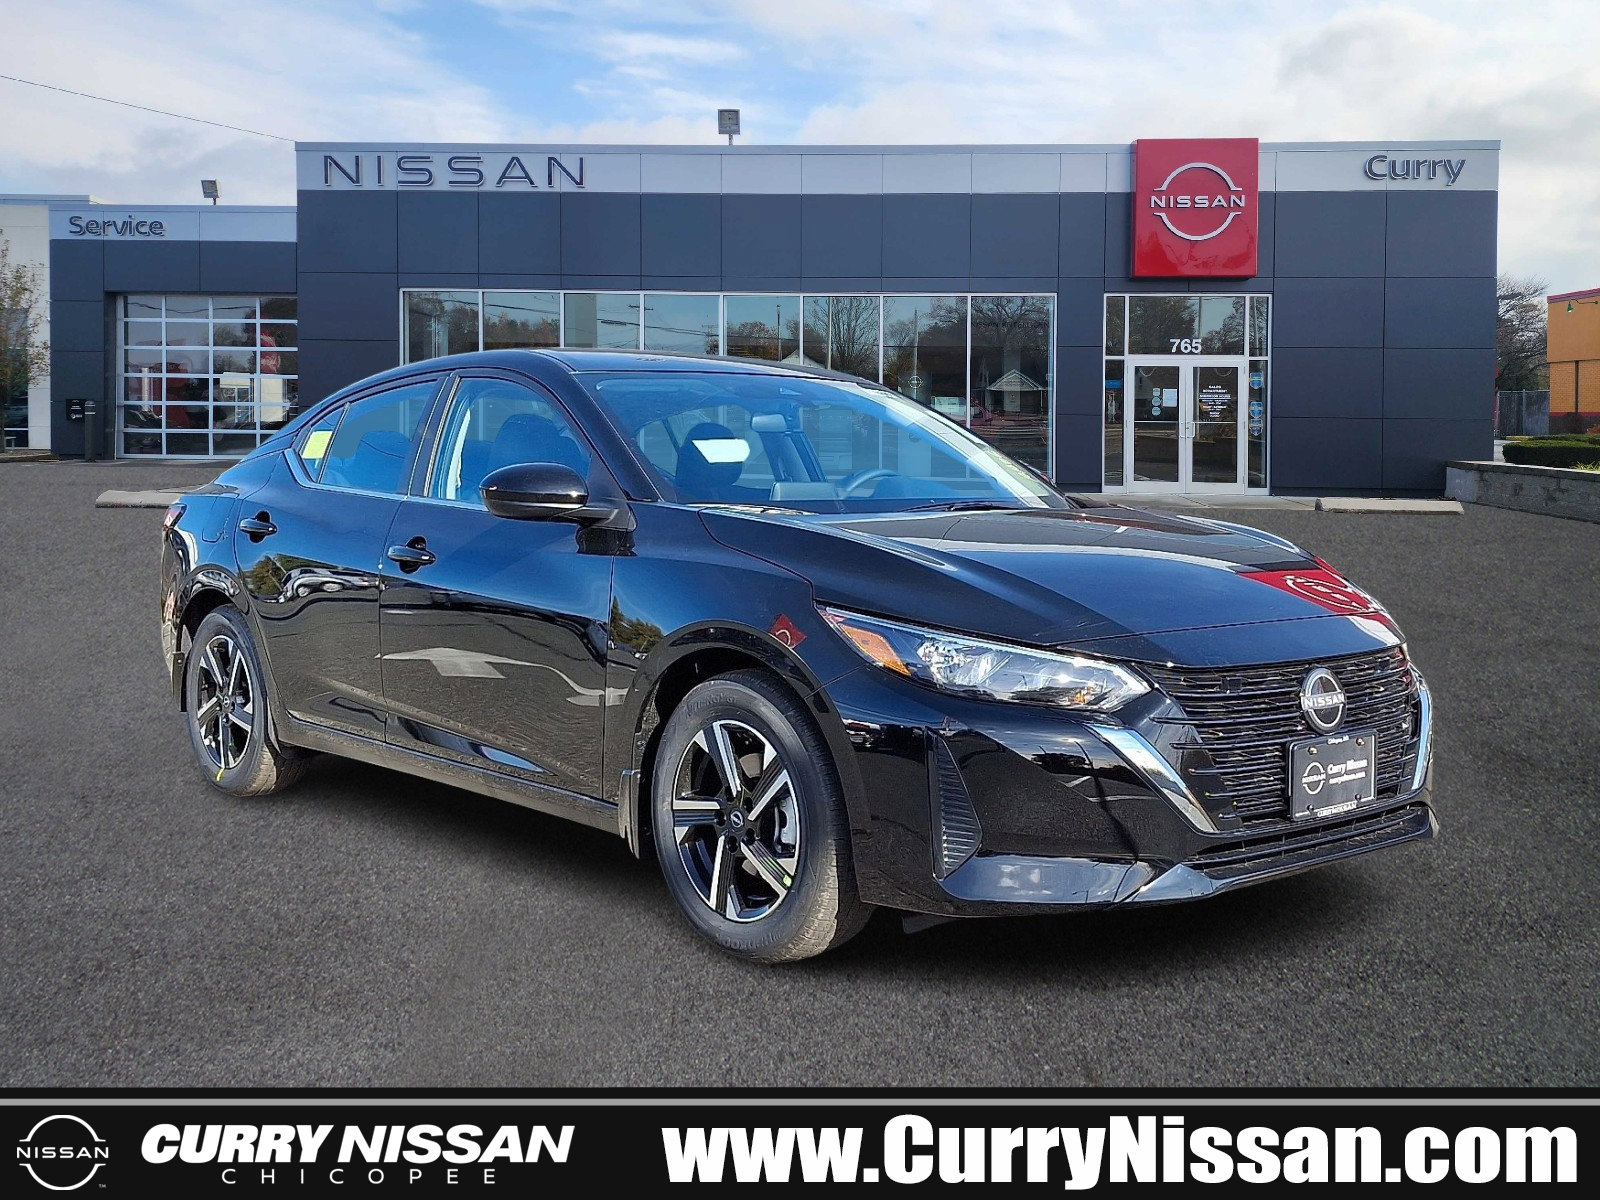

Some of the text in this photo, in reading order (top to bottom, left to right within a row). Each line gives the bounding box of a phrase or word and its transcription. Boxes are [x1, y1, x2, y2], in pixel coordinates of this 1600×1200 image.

[323, 155, 585, 188] NISSAN
[1365, 154, 1467, 186] Curry
[1150, 195, 1246, 208] NISSAN
[68, 214, 166, 236] Service
[1169, 338, 1202, 354] 765
[1304, 692, 1345, 707] NISSAN
